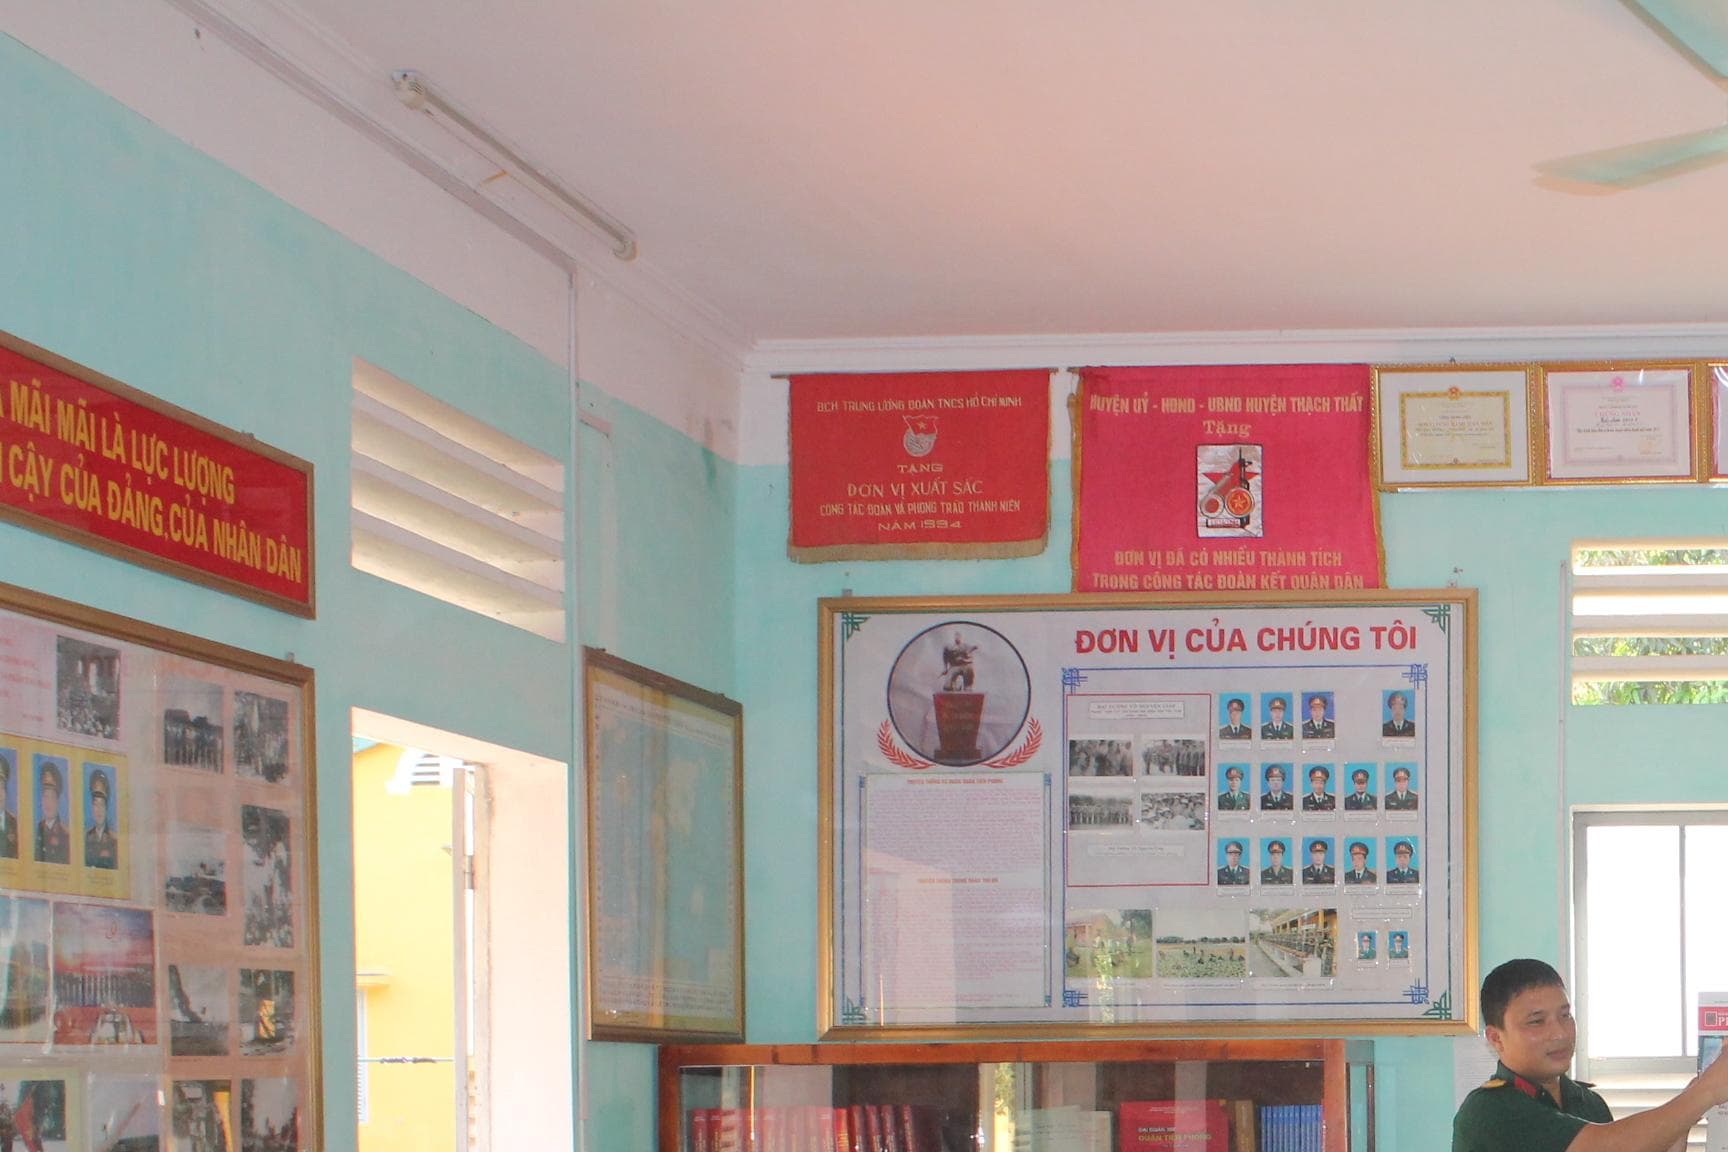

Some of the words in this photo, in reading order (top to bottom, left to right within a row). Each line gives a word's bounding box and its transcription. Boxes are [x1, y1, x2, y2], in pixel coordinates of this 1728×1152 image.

[817, 401, 839, 413] BCH
[843, 400, 875, 412] TRUNG
[938, 398, 964, 409] TNCS
[1089, 394, 1129, 416] HUYỆN
[1208, 397, 1242, 413] UBND
[1246, 395, 1287, 416] HUYỆN
[1291, 397, 1330, 416] THẠCH
[1334, 392, 1364, 413] THẤT
[1203, 420, 1253, 437] Tặng
[10, 378, 50, 435] MÃI
[57, 398, 96, 452] MÃI
[102, 411, 126, 464] LÀ
[131, 430, 168, 485] LỰC
[173, 446, 235, 505] LƯỢNG
[848, 482, 884, 498] ĐƠN
[890, 482, 906, 500] VỊ
[911, 476, 949, 497] XUẤT
[952, 479, 984, 495] SẮC
[8, 442, 53, 502] CẬY
[60, 453, 102, 516] CỦA
[169, 494, 208, 552] CỦA
[213, 520, 261, 570] NHÂN
[266, 535, 301, 583] DÂN
[968, 500, 998, 513] THANH
[999, 499, 1021, 512] NIÊN
[1114, 549, 1144, 567] ĐƠN
[1149, 551, 1163, 570] VỊ
[1190, 547, 1209, 567] CÓ
[1213, 545, 1255, 567] NHIỀU
[1259, 546, 1306, 567] THÀNH
[1310, 546, 1342, 567] TÍCH
[1092, 572, 1139, 590] TRONG
[1143, 569, 1182, 590] CÔNG
[1187, 569, 1213, 590] TÁC
[1217, 569, 1257, 590] ĐOÀN
[1261, 568, 1287, 590] KẾT
[1291, 569, 1330, 590] QUÂN
[1334, 570, 1364, 590] DÂN
[1075, 628, 1139, 654] ĐƠN
[1148, 628, 1176, 660] VỊ
[1185, 617, 1248, 654] CỦA
[1256, 618, 1361, 652] CHÚNG
[1370, 619, 1417, 650] TÔI
